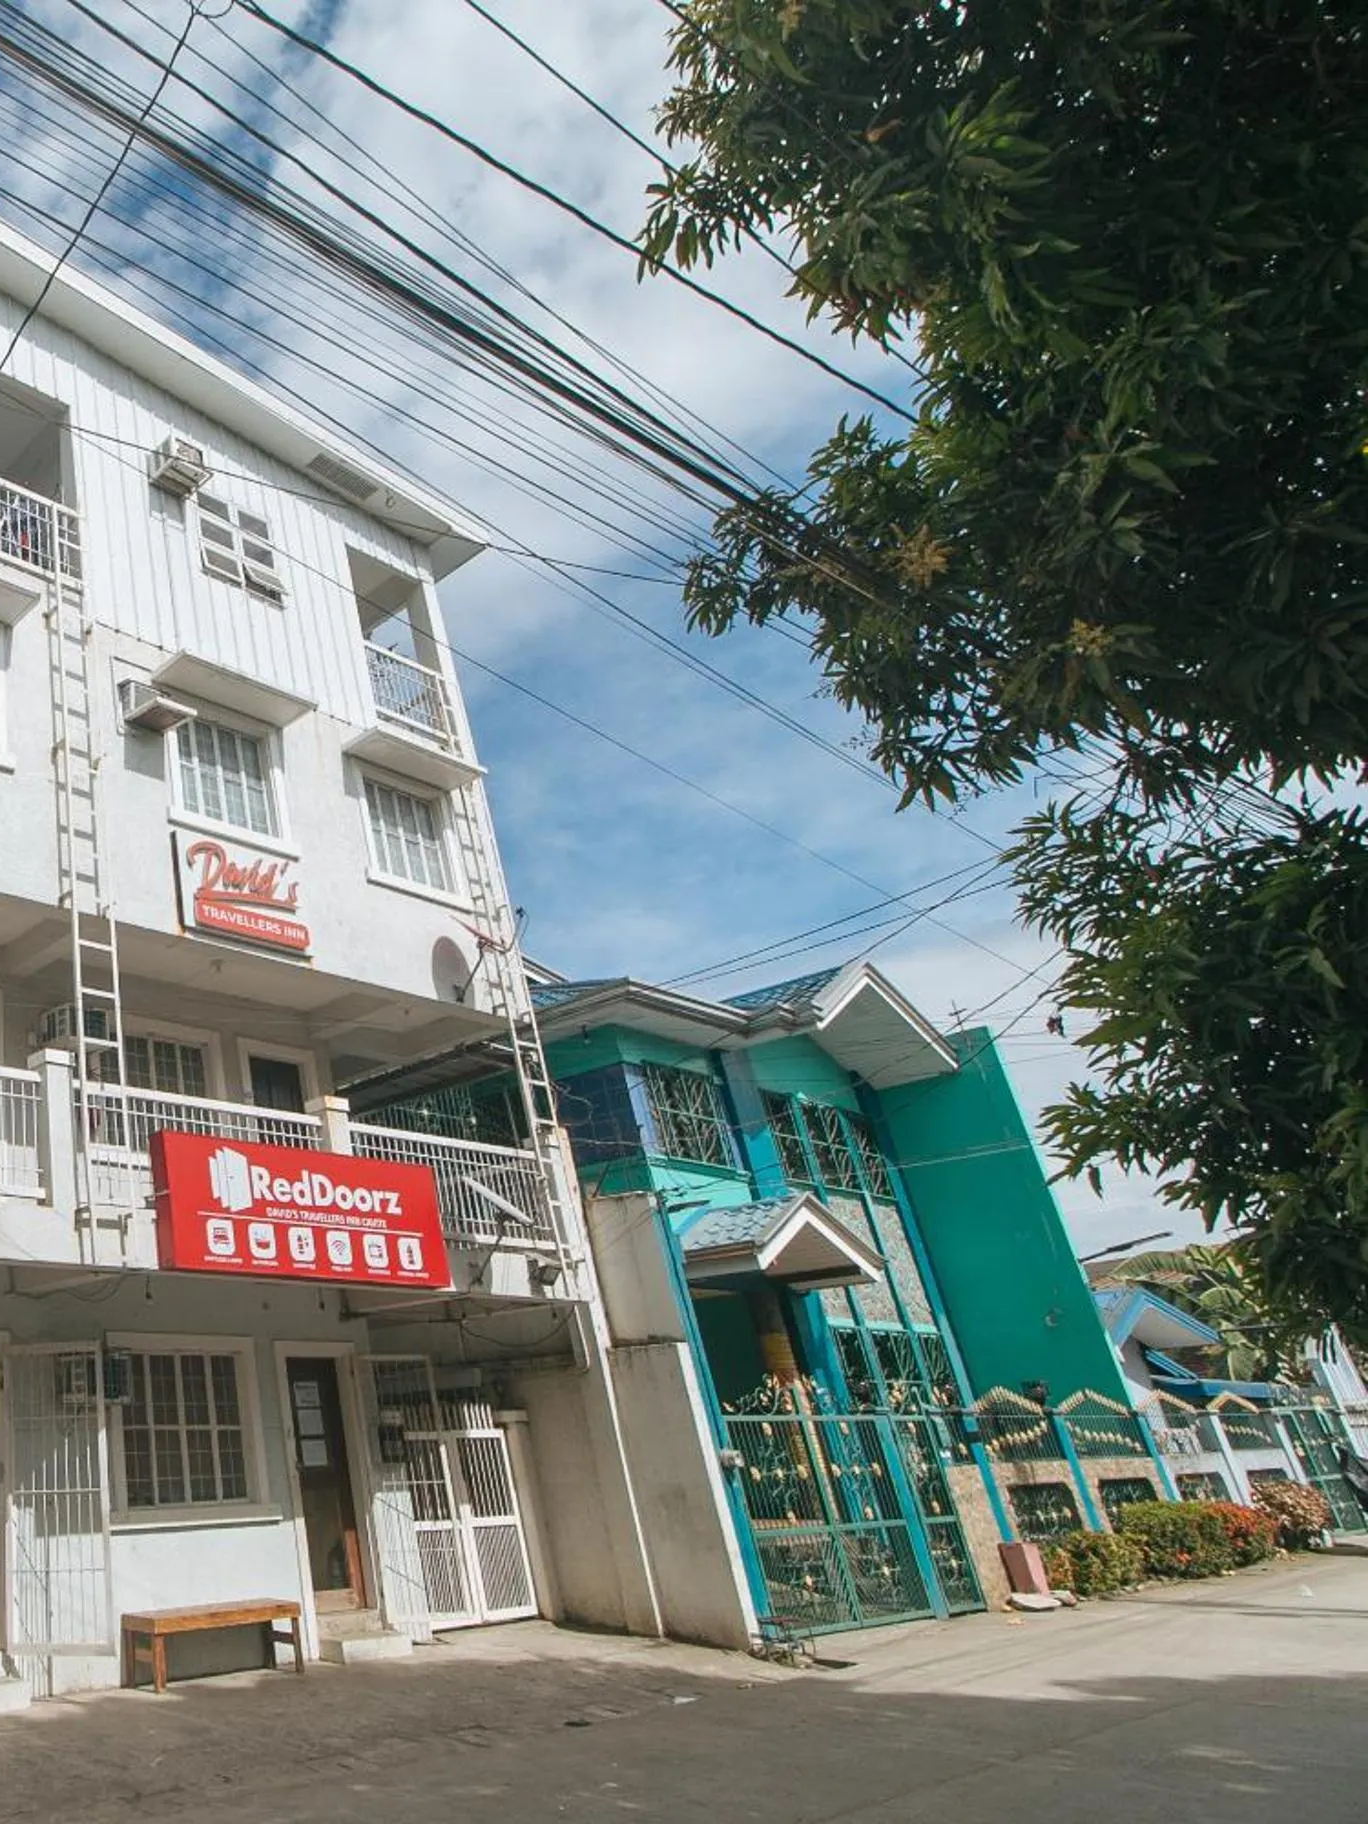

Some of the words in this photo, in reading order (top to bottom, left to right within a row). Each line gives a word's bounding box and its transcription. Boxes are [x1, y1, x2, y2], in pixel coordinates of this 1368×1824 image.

[186, 840, 299, 902] David's
[202, 905, 282, 935] TRAVELLERS
[284, 925, 306, 941] INN
[250, 1164, 403, 1215] RedDoorz
